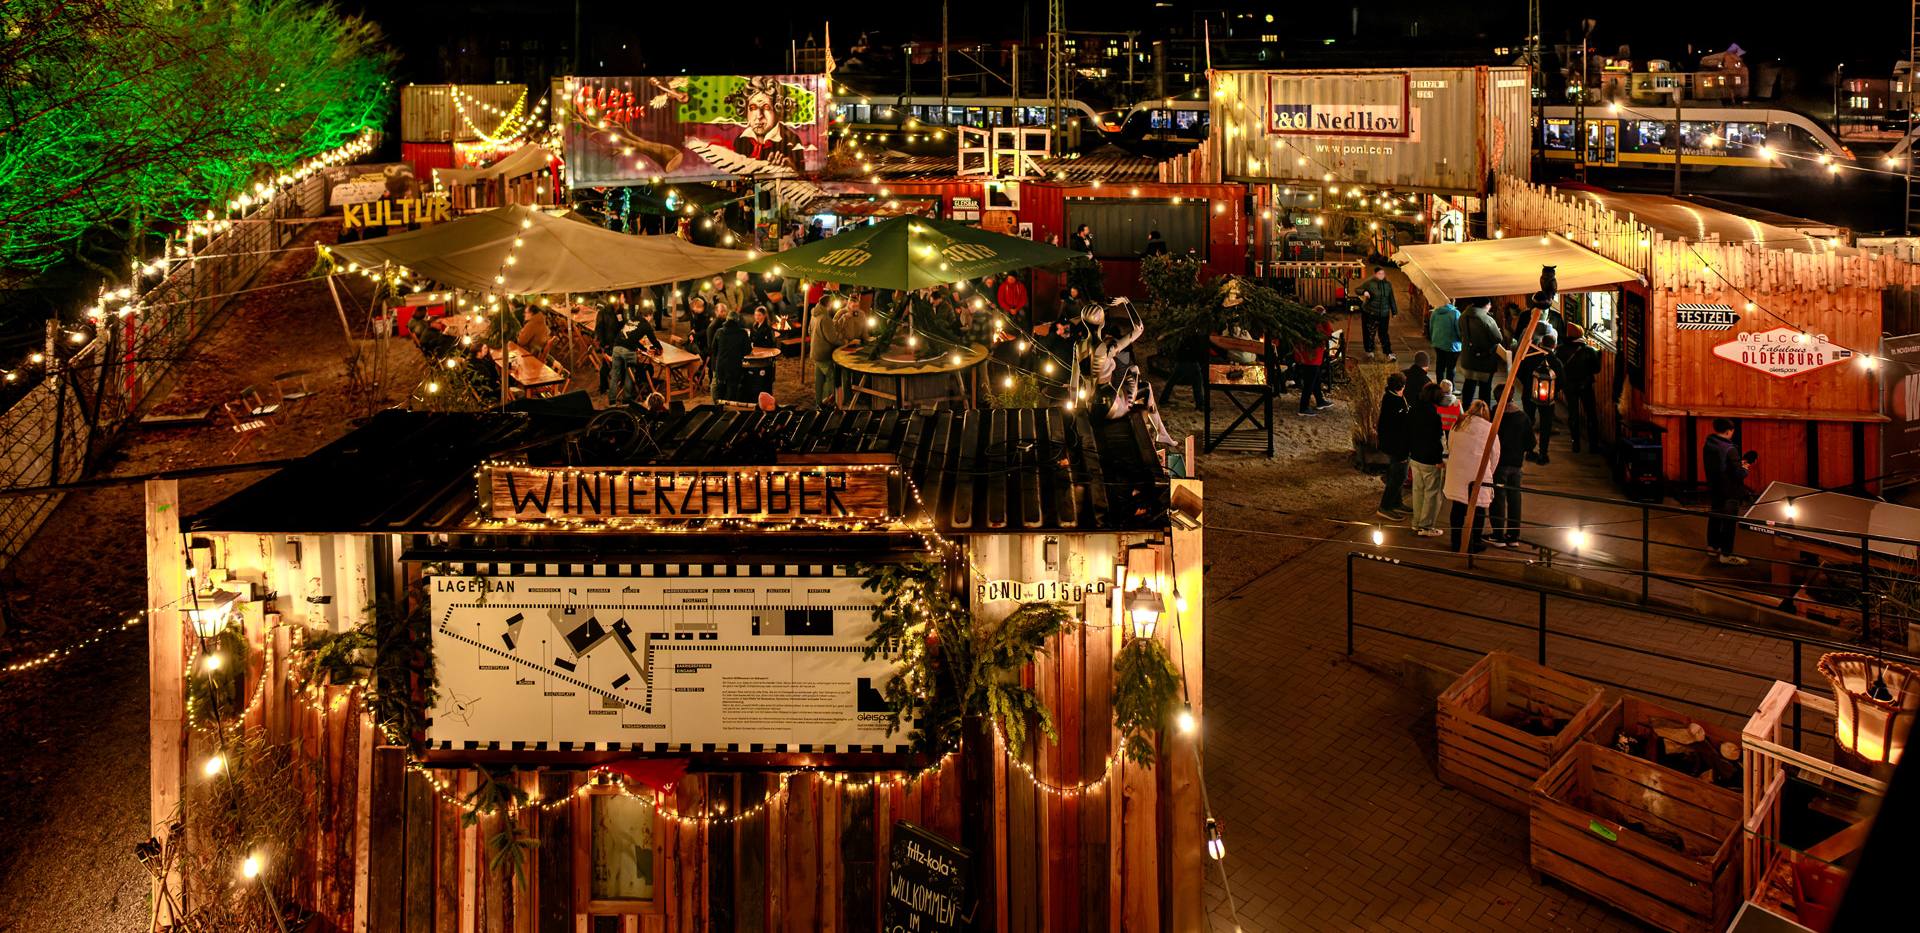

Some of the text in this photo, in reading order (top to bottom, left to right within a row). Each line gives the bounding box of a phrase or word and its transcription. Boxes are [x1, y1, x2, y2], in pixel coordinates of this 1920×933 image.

[957, 125, 1051, 177] BAR
[342, 195, 453, 230] KULTUR
[817, 248, 872, 267] JEVER
[942, 243, 998, 262] JEVER
[1758, 344, 1807, 353] Fabulous
[1742, 351, 1824, 366] OLDENBURG
[437, 580, 515, 593] LAGEPLAN
[978, 581, 1021, 600] PONU
[907, 840, 949, 876] fritz-kola
[890, 870, 957, 927] WILLKOMMEN
[909, 912, 921, 932] IM
